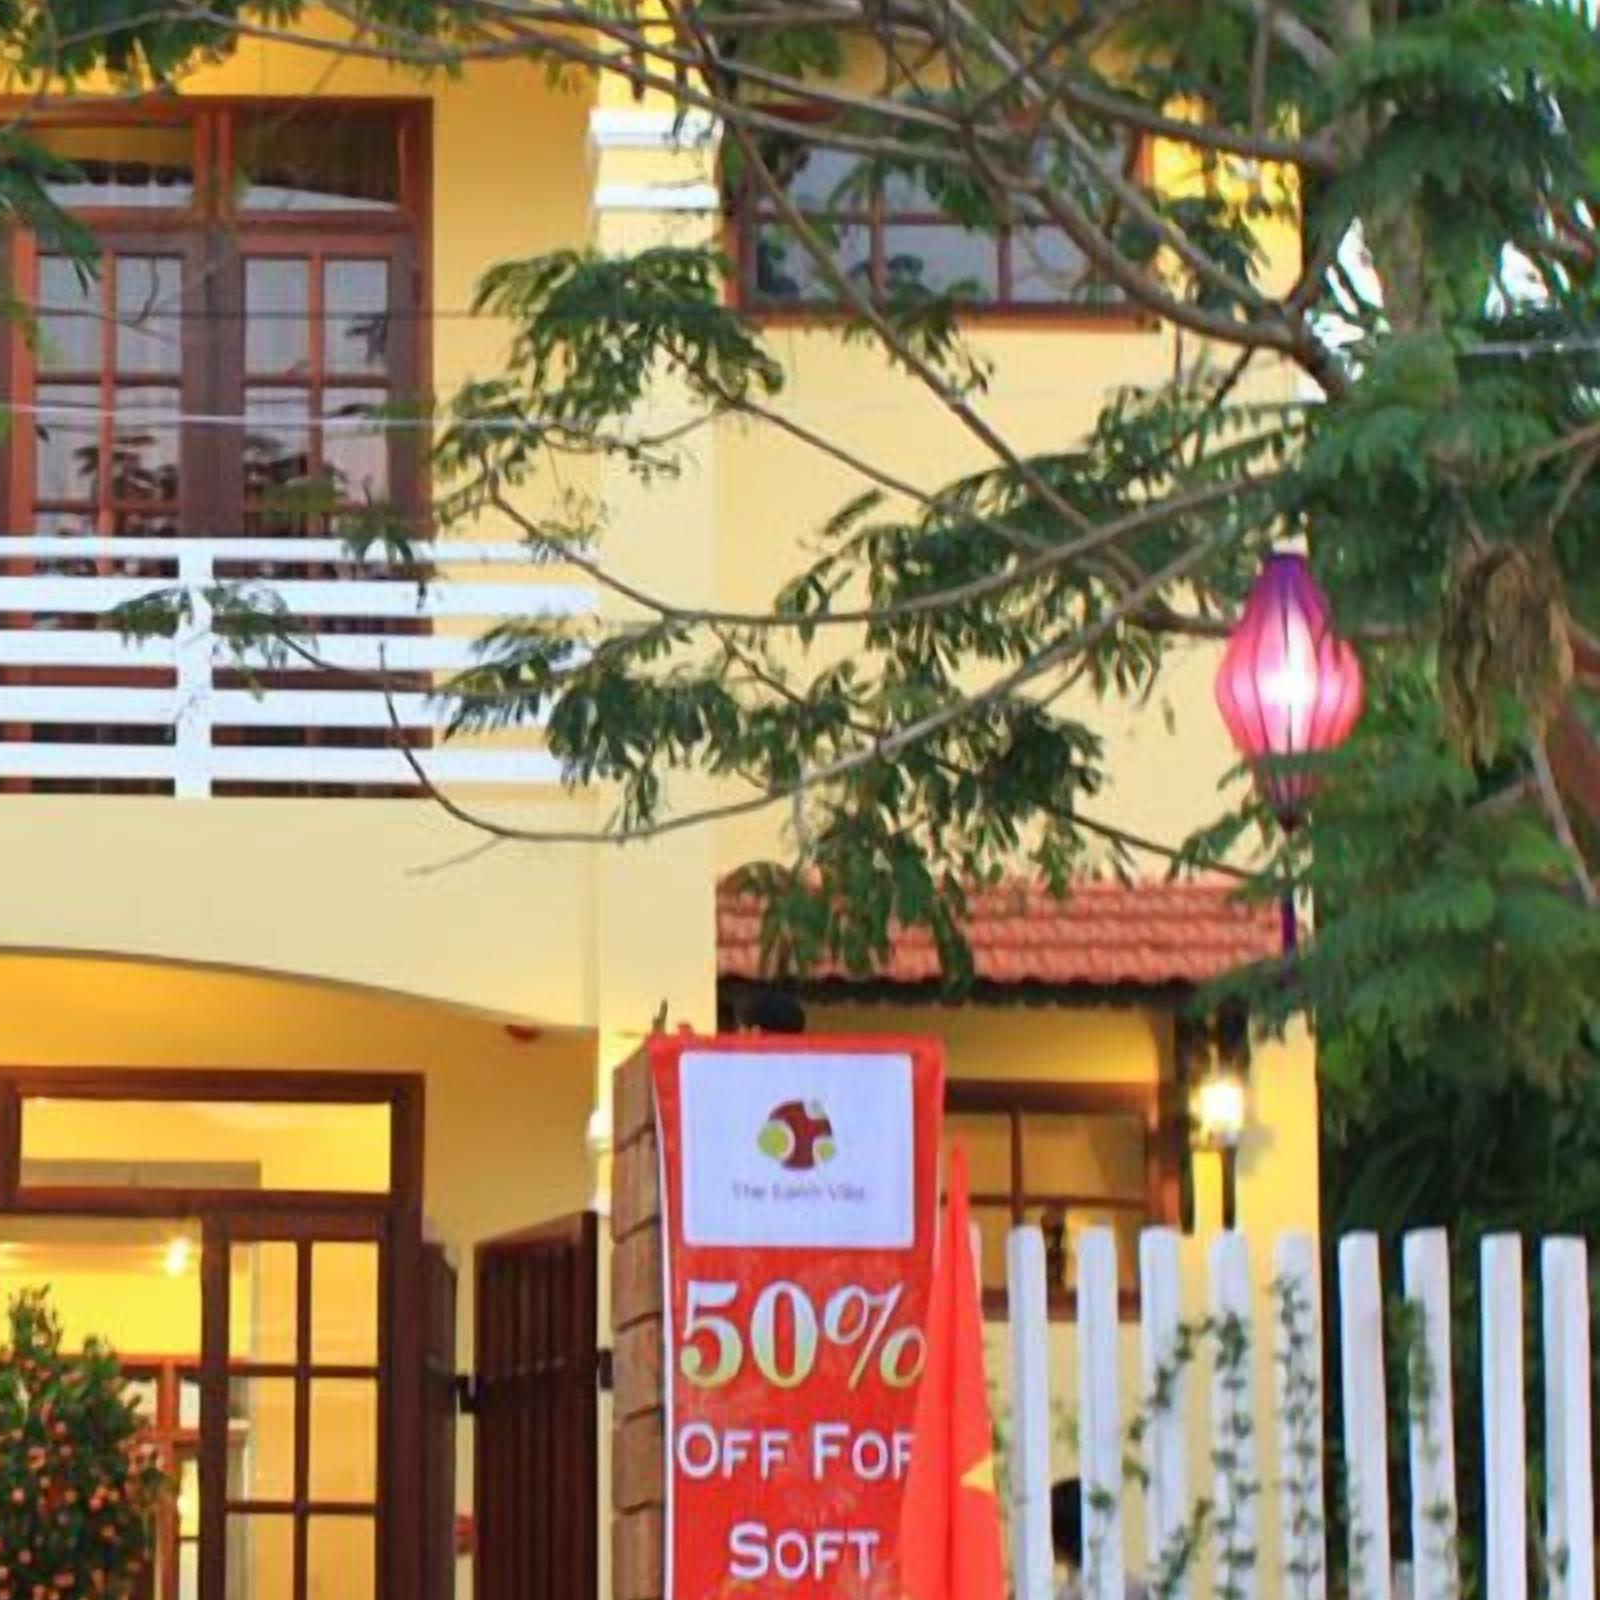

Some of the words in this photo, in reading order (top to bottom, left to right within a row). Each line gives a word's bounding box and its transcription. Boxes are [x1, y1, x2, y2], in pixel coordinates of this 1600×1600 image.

[680, 1279, 928, 1391] 50%
[678, 1422, 790, 1480] OFF
[728, 1520, 881, 1580] SOFT
